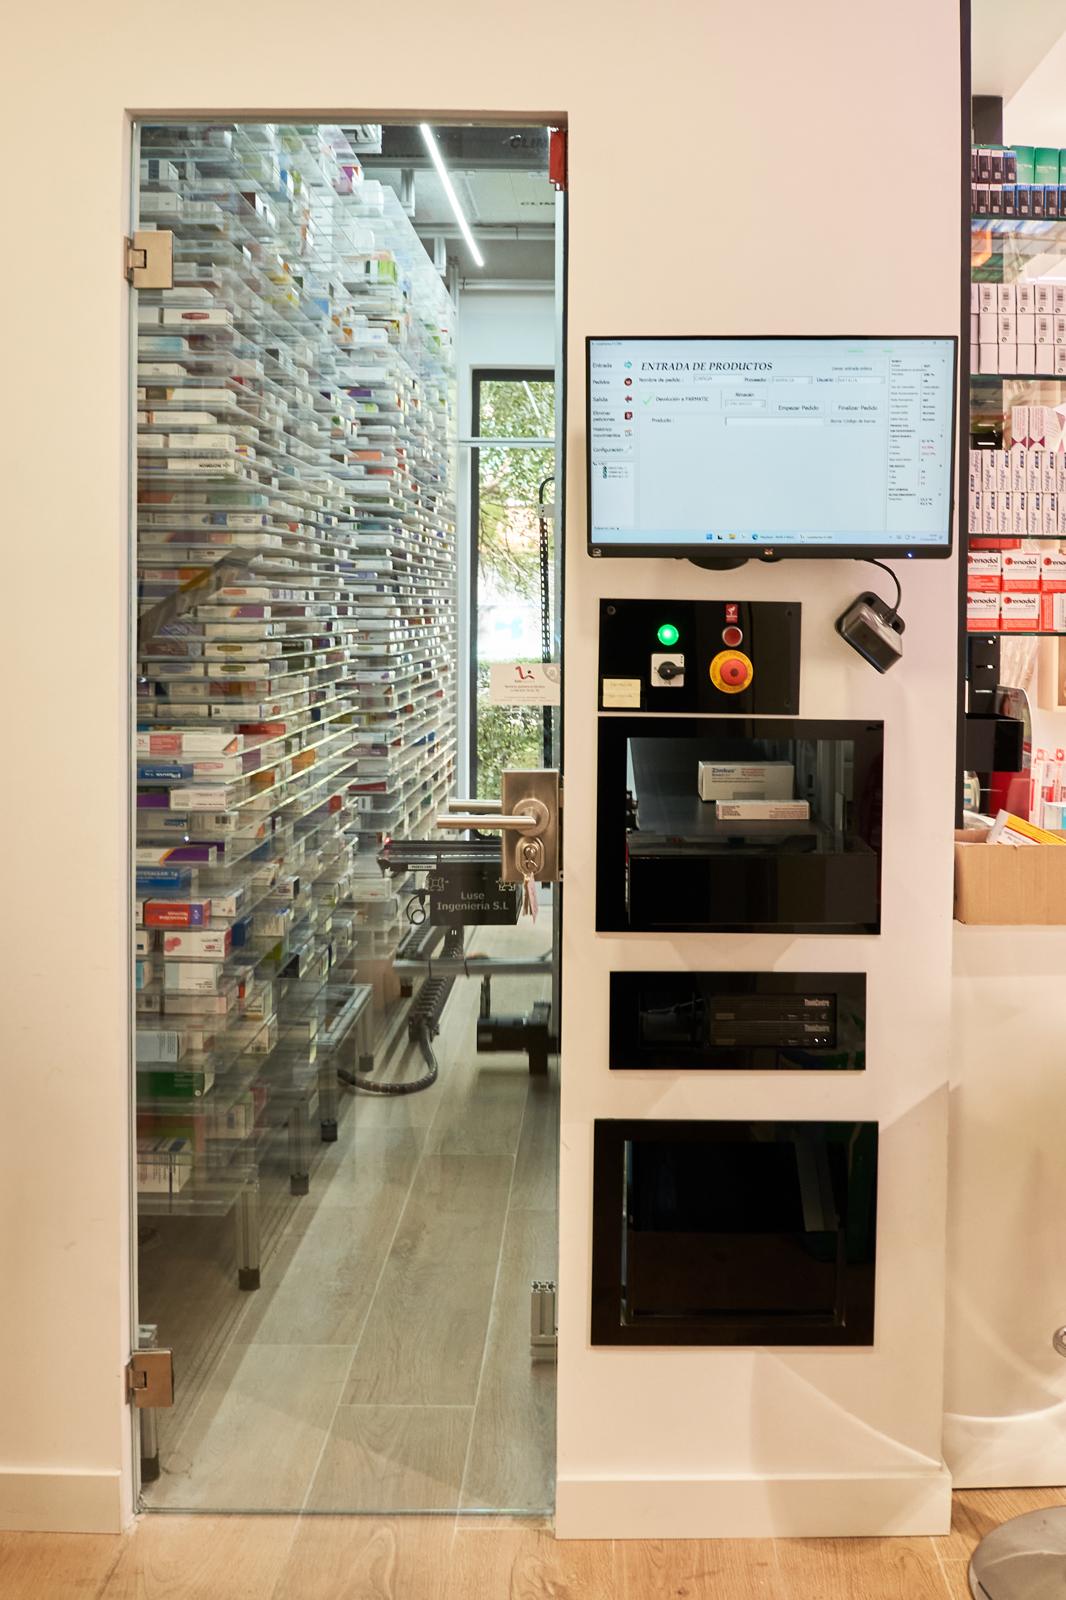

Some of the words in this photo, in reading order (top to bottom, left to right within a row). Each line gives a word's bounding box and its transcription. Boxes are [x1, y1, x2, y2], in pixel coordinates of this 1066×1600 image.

[642, 361, 689, 372] ENTRADA
[692, 361, 707, 372] DE
[709, 361, 773, 372] PRODUCTOS
[460, 891, 485, 900] Luse
